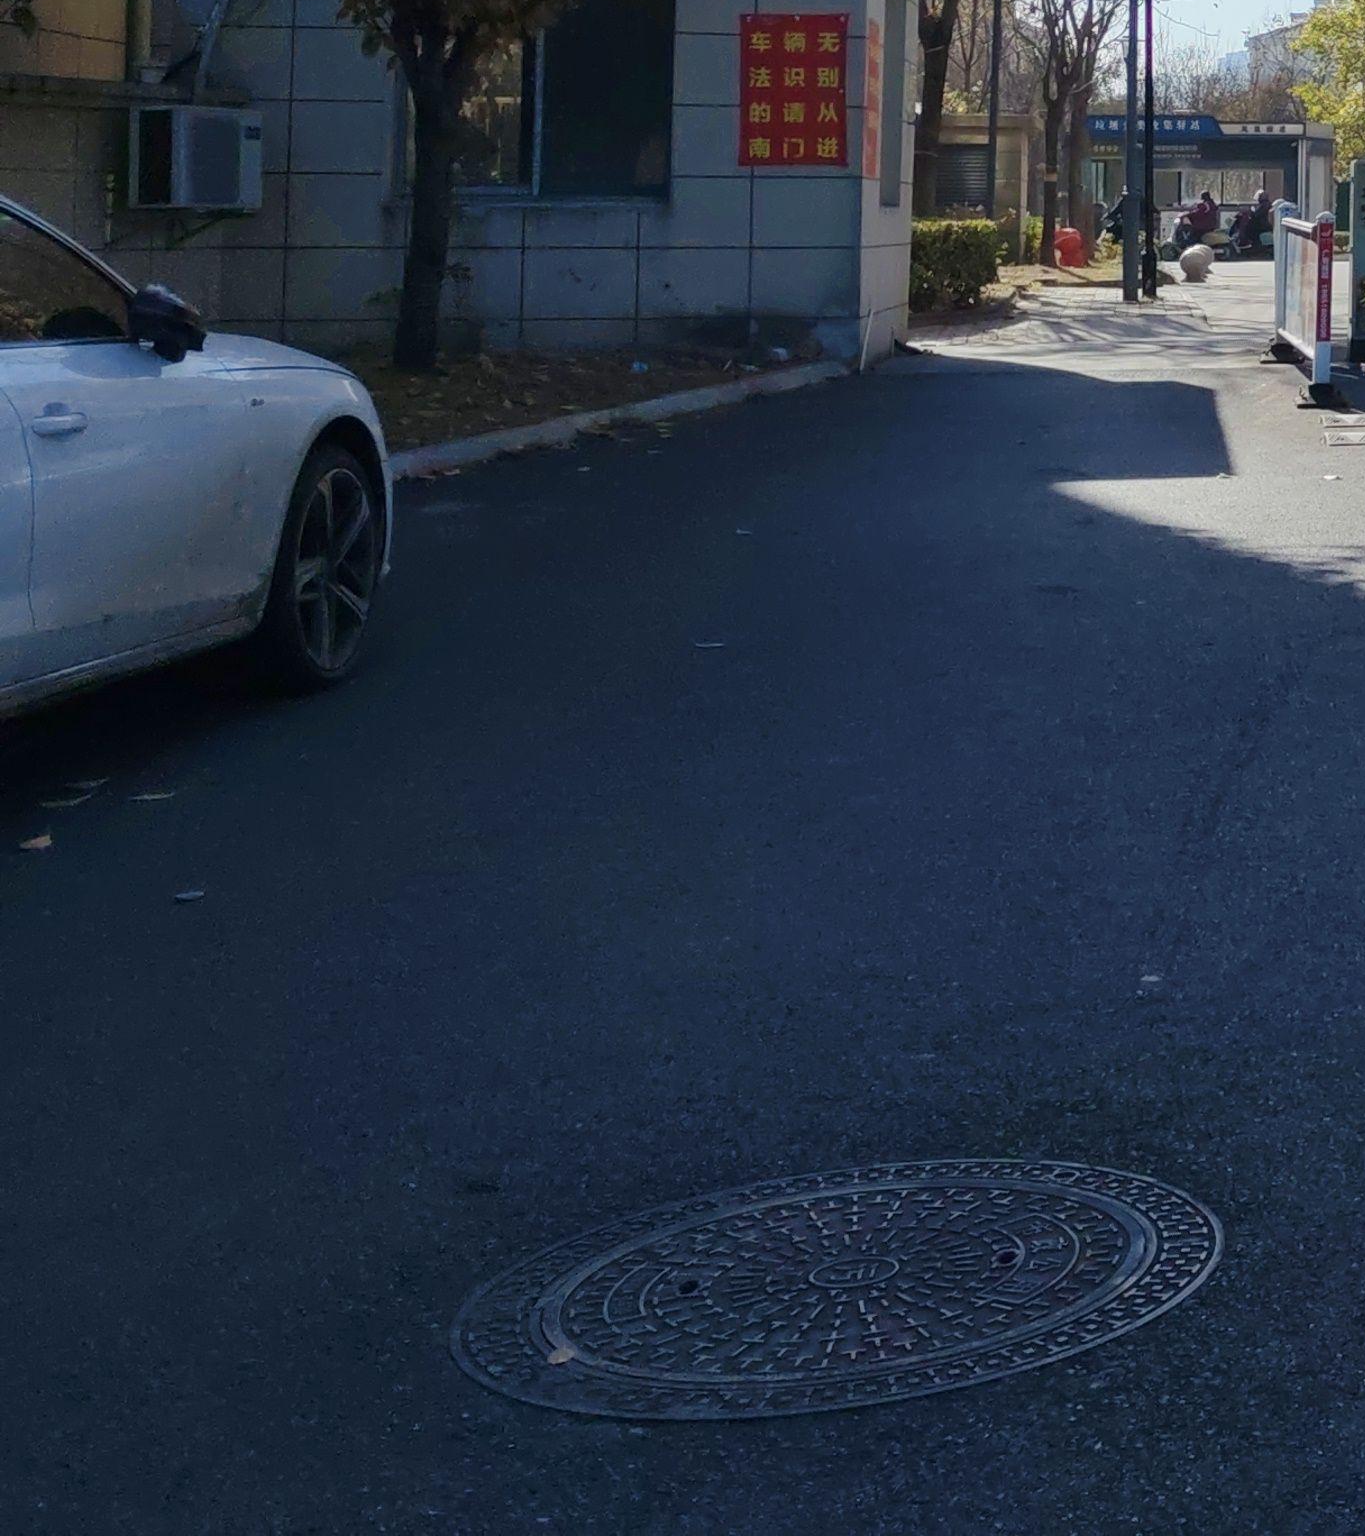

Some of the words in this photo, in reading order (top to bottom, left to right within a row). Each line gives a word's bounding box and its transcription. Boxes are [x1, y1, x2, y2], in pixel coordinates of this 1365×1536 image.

[749, 31, 840, 53] 车辆无
[749, 67, 839, 88] 法识别
[749, 102, 839, 124] 的请从
[749, 137, 839, 159] 南门进
